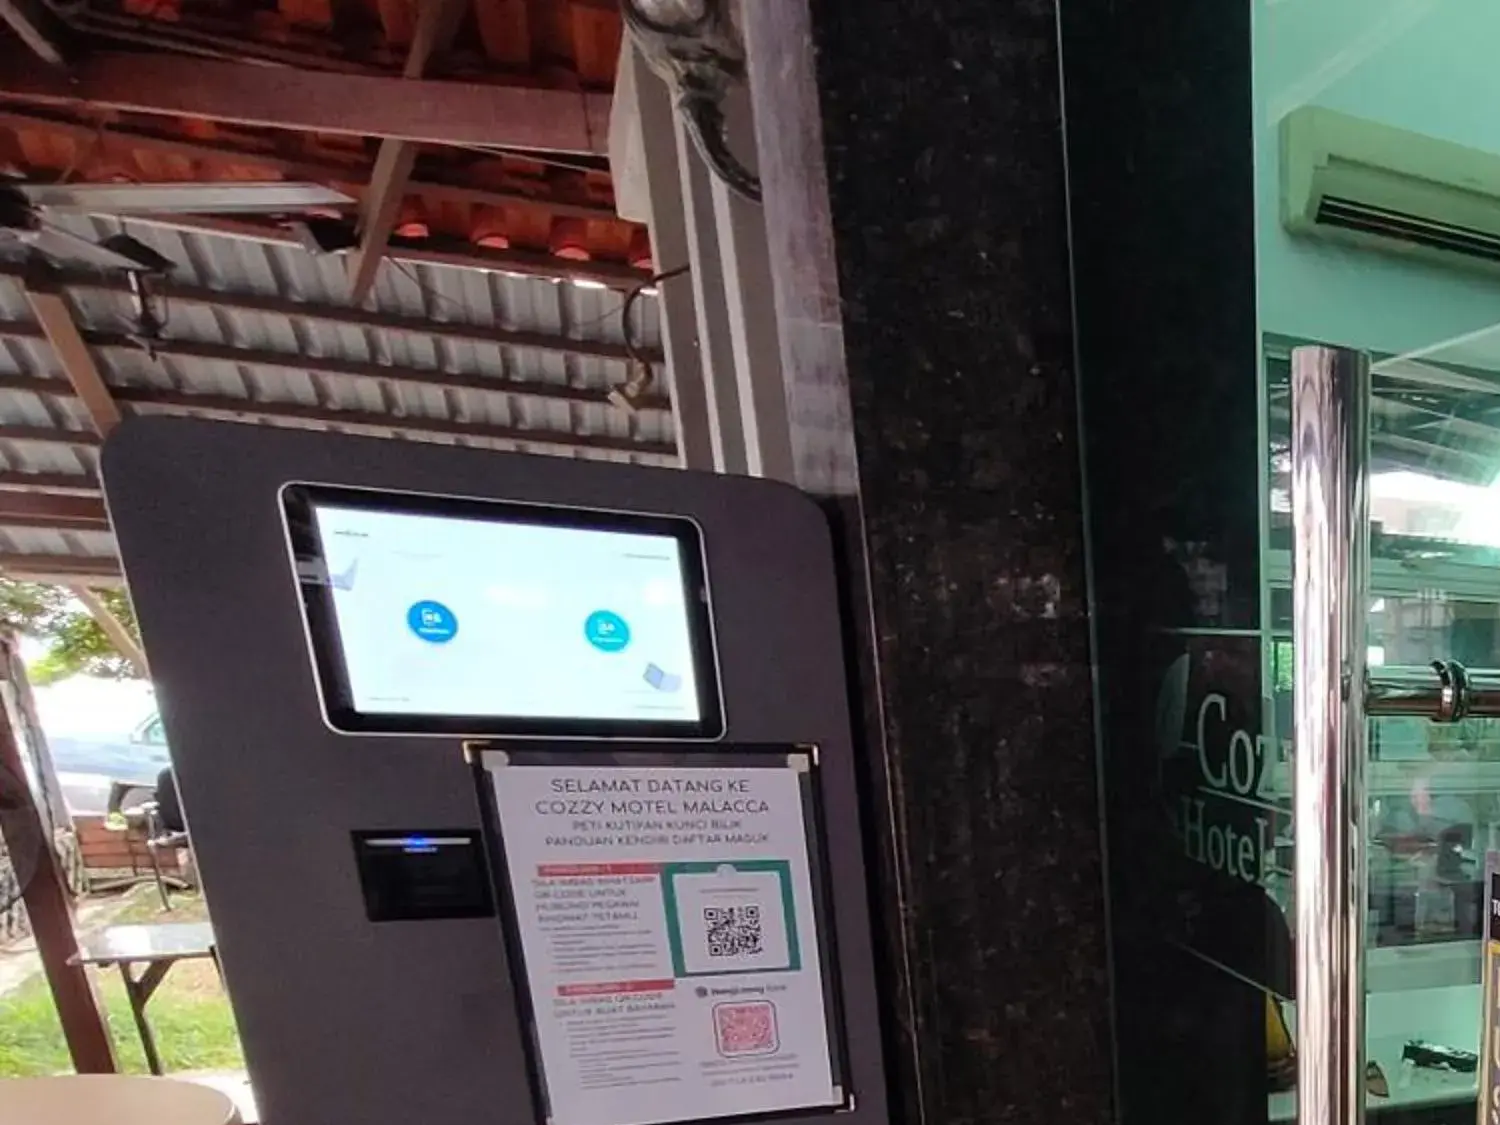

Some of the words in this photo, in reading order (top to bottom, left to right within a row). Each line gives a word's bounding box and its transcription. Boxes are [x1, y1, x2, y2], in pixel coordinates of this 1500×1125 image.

[551, 779, 641, 793] SELAMAT
[648, 779, 723, 793] DATANG
[728, 779, 751, 793] KE
[535, 800, 605, 815] COZZY
[611, 799, 677, 815] MOTEL
[683, 799, 769, 814] MALACCA
[545, 835, 614, 847] PANDUAN
[1183, 795, 1269, 887] Hotel
